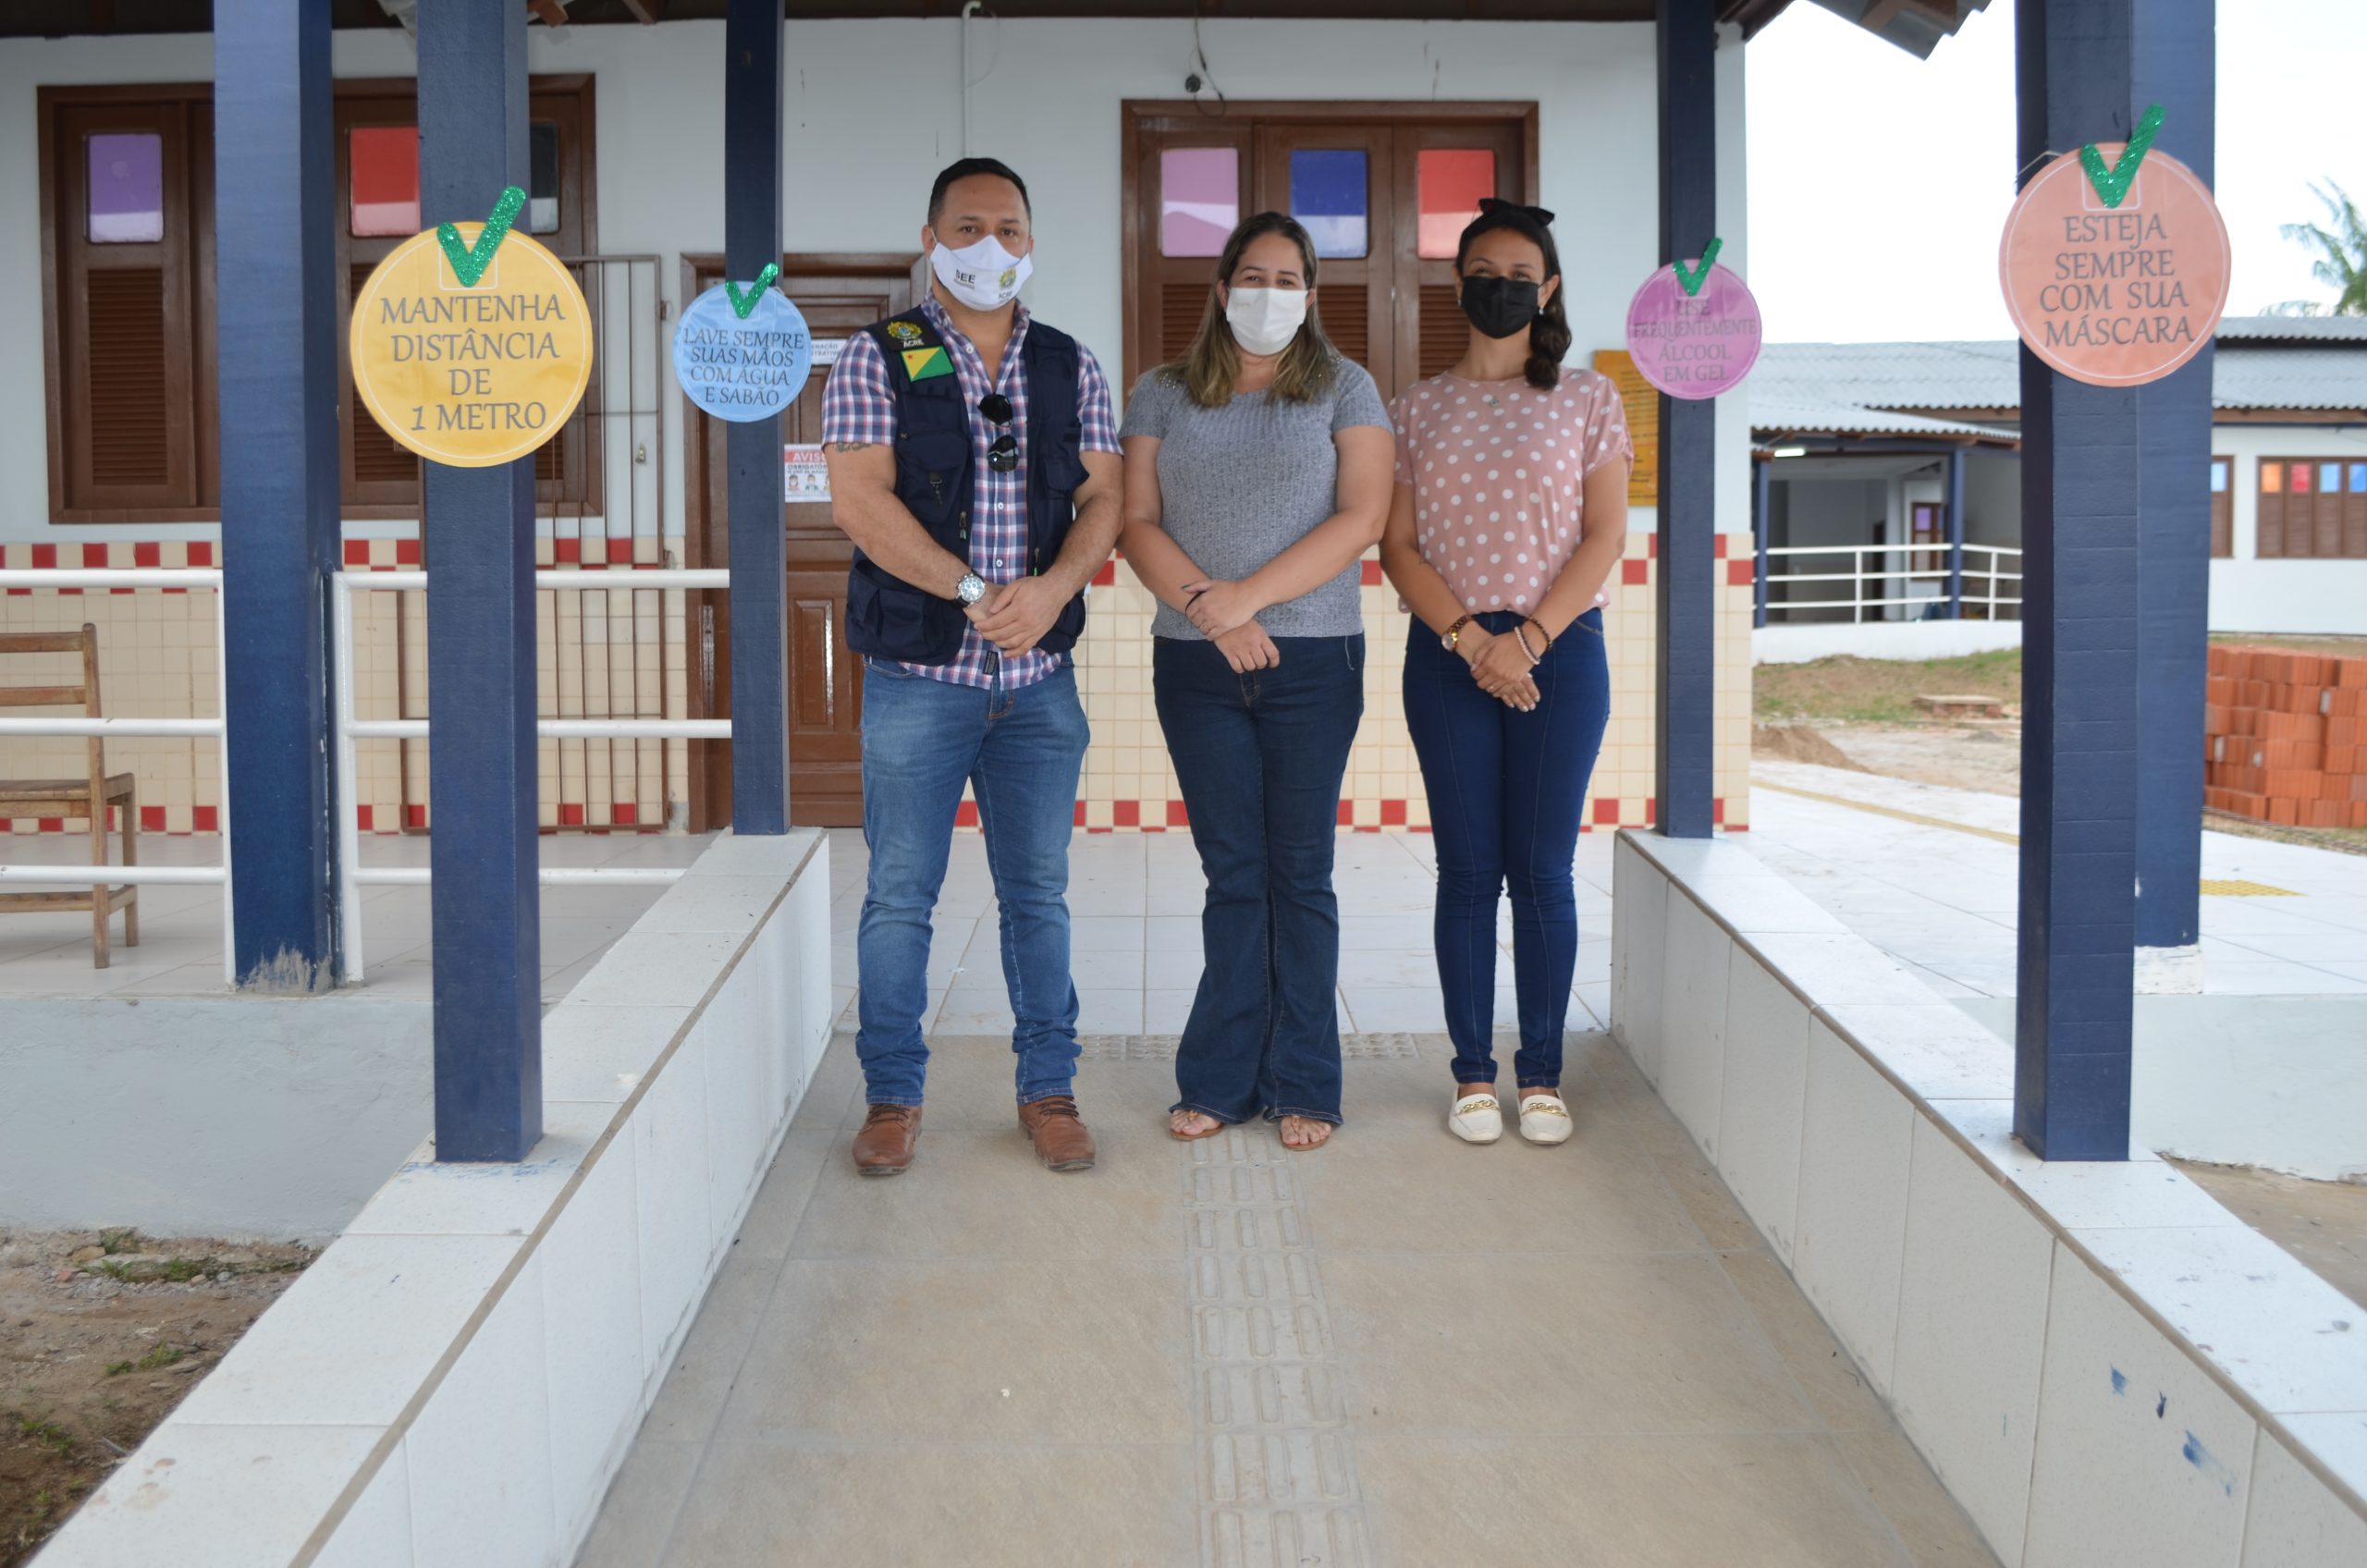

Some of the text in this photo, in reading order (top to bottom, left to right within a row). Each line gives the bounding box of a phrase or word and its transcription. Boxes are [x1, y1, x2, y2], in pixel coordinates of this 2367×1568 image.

[2063, 213, 2167, 250] ESTEJA
[2054, 250, 2176, 280] SEMPRE
[380, 294, 565, 324] MANTENHA
[1675, 300, 1711, 316] USE
[2039, 281, 2189, 312] COM SUA
[390, 327, 560, 361] DISTÂNCIA
[683, 327, 804, 349] LAVE SEMPRE
[1633, 319, 1757, 341] FREQUENTEMENTE
[2044, 314, 2195, 348] MÁSCARA
[691, 348, 794, 367] SUAS MÃOS
[448, 368, 492, 396] DE
[690, 364, 791, 386] COM ÁGUA
[1664, 364, 1730, 383] EM GEL
[705, 386, 779, 406] E SABÃO
[410, 401, 546, 431] 1 METRO
